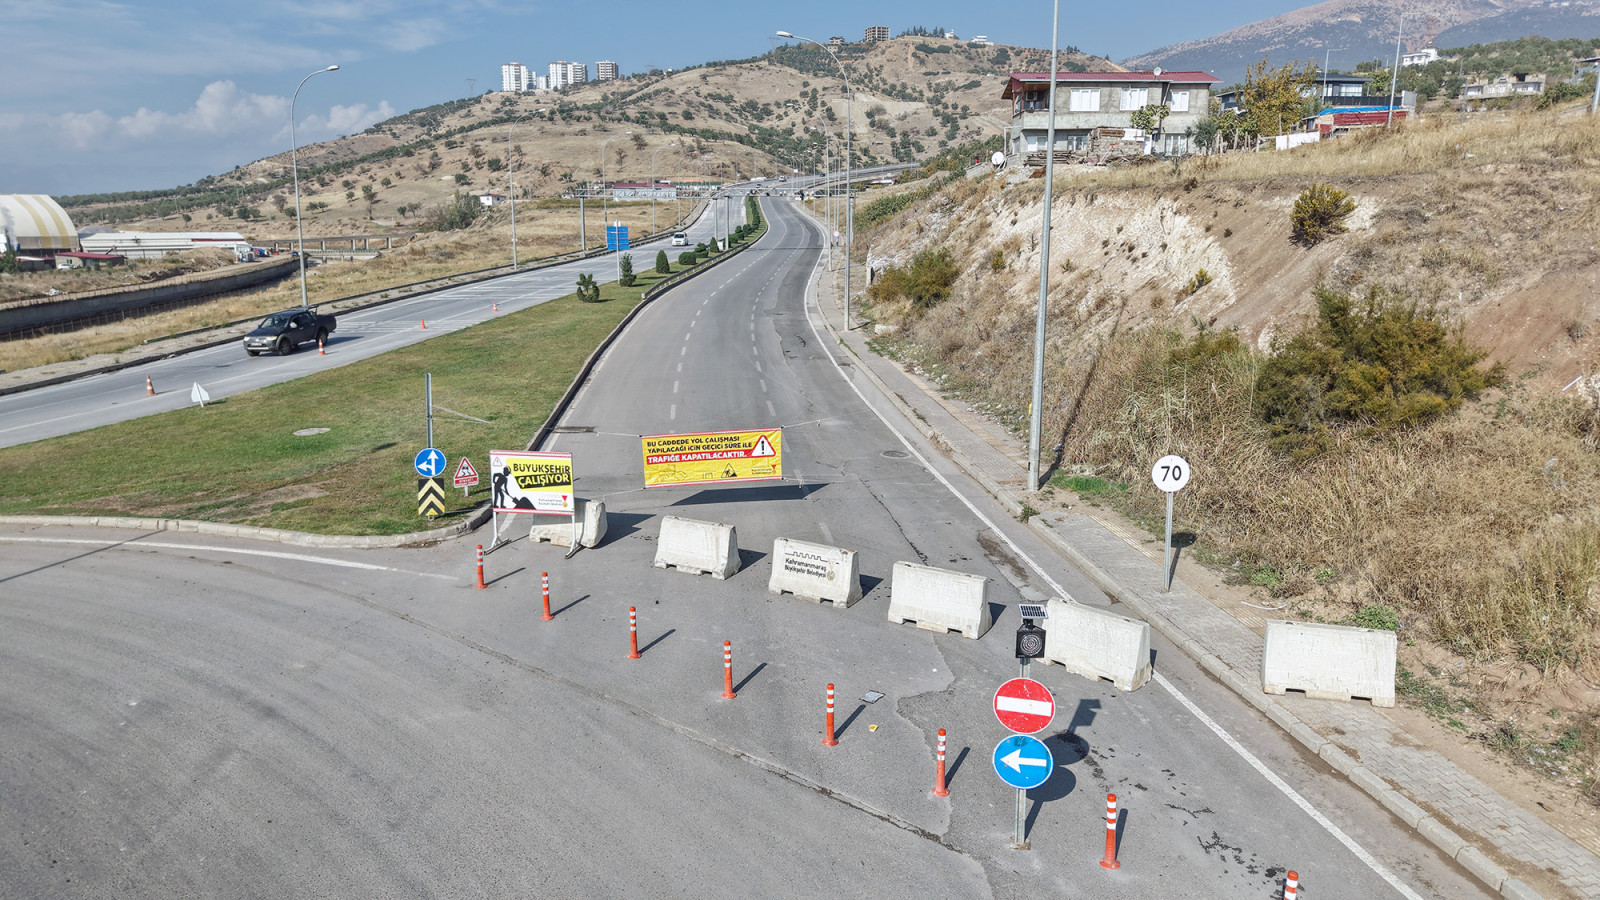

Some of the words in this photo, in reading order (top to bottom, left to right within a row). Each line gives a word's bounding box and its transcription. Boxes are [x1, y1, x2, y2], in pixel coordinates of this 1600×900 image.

[648, 445, 686, 453] YAPILACAĞI
[513, 463, 570, 474] BÜYÜKŞEHİR
[1161, 465, 1182, 482] 70
